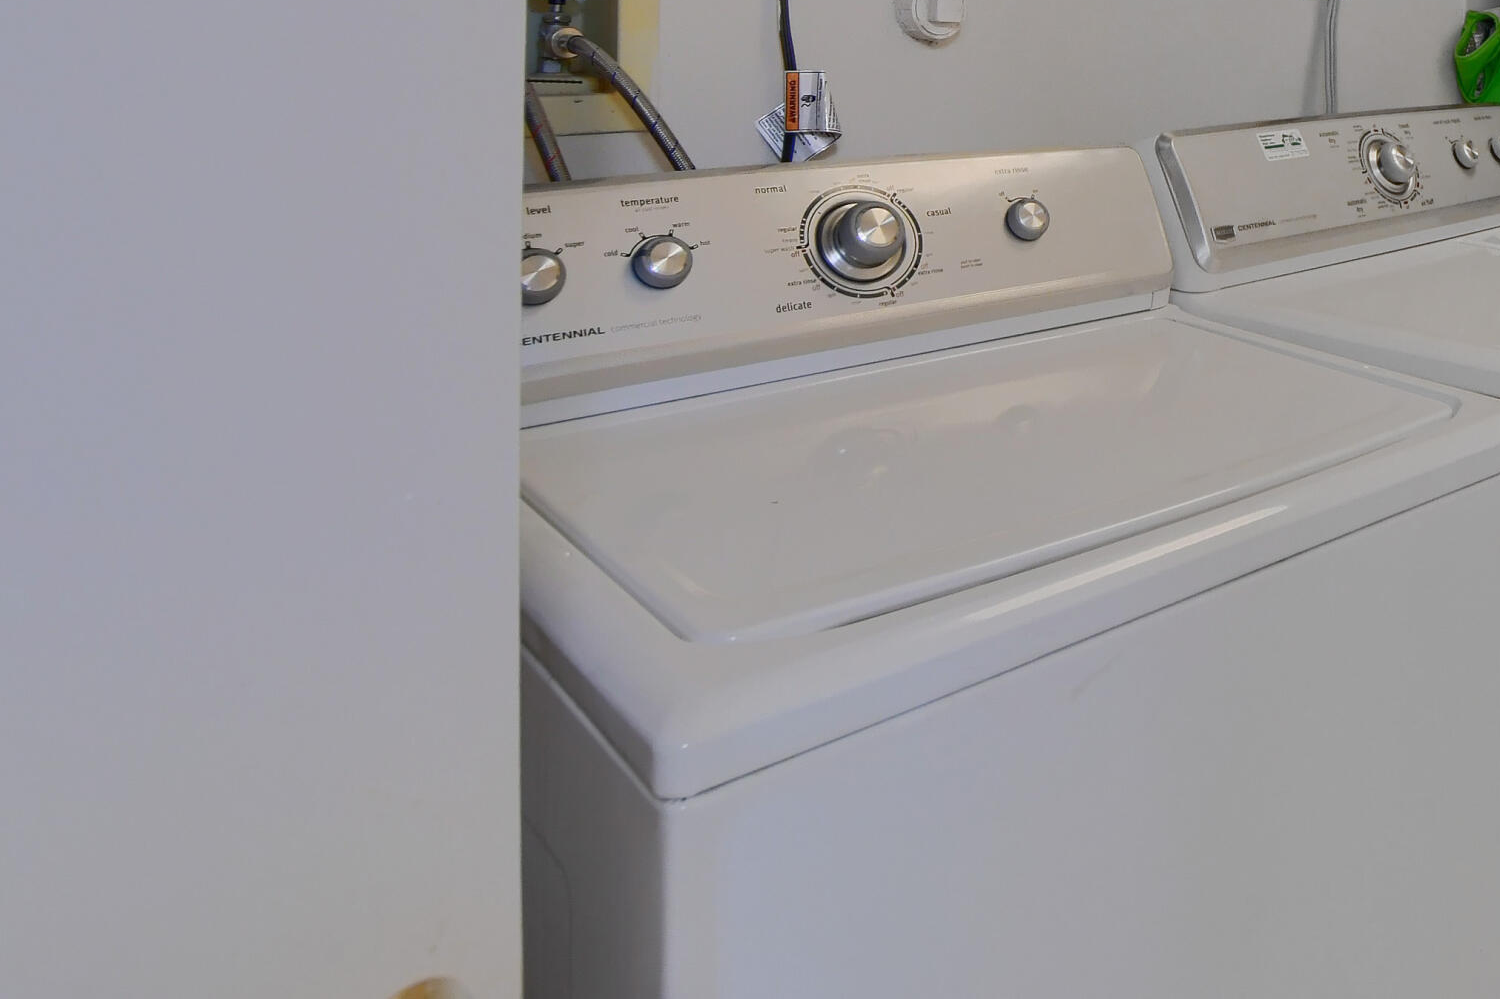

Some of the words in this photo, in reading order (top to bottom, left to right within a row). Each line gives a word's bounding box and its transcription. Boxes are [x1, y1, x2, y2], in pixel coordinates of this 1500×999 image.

[788, 80, 797, 116] WARNING
[755, 185, 787, 194] normal
[620, 195, 680, 208] temperature
[525, 205, 551, 215] level
[926, 207, 952, 217] casual
[624, 226, 639, 234] cool
[522, 232, 542, 240] dium
[603, 249, 618, 257] cold
[776, 301, 812, 314] delicate
[521, 326, 606, 346] ENTENNIAL
[610, 319, 657, 333] commercial
[658, 314, 703, 326] technology
